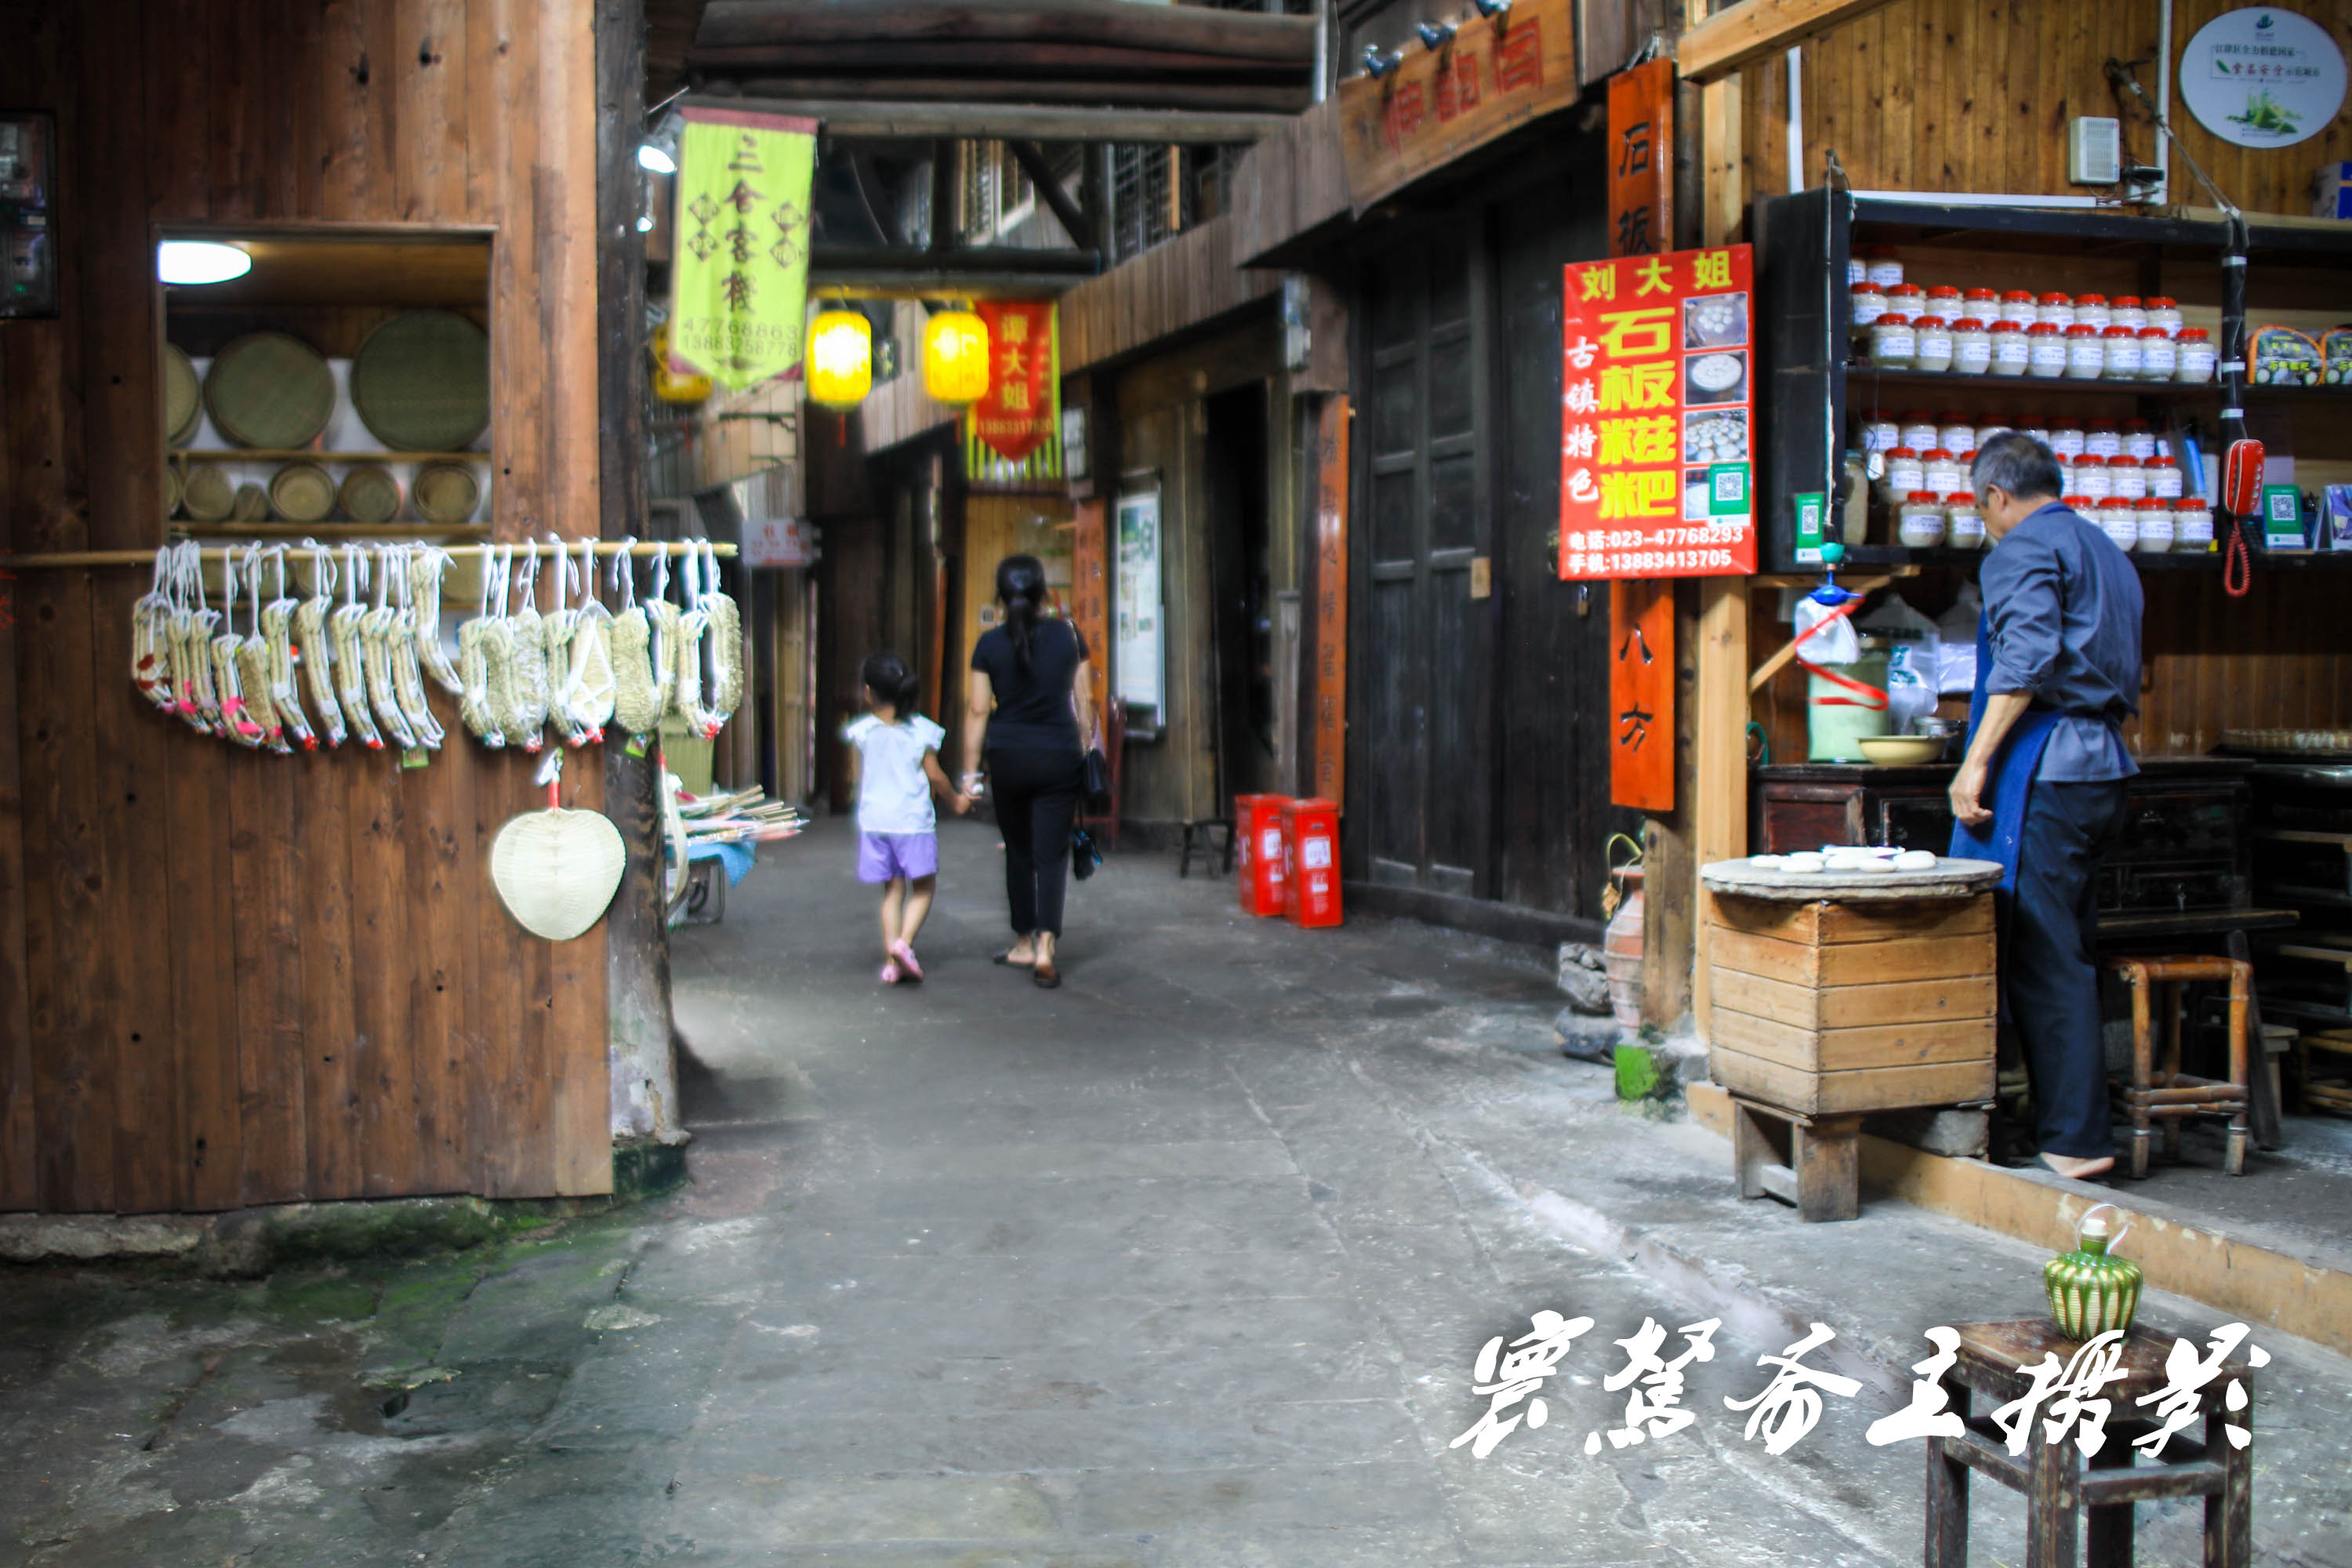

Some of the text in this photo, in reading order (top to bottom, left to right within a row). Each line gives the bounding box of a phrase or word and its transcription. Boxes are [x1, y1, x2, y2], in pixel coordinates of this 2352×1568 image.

[1581, 250, 1733, 303] 刘大姐
[1566, 336, 1600, 503] 古镇特色
[1598, 307, 1676, 518] 石板糍粑
